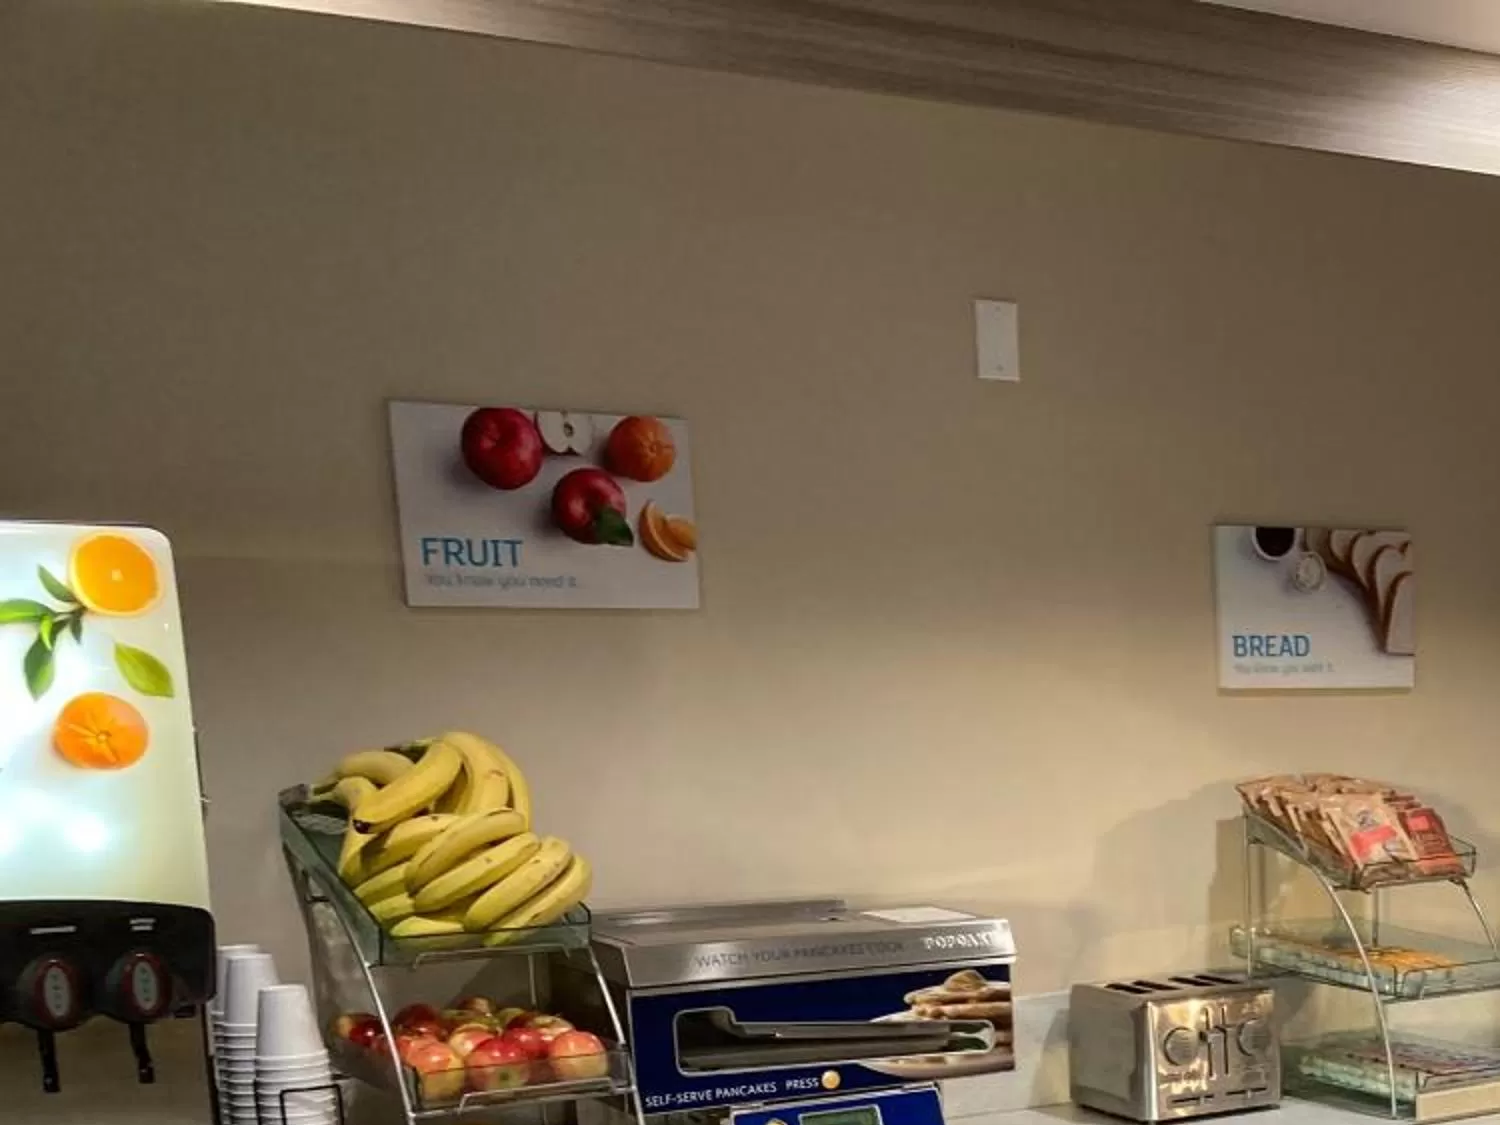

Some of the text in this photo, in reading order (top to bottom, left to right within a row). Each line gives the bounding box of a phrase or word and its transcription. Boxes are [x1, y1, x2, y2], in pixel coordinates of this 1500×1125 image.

[421, 537, 524, 568] FRUIT
[1232, 635, 1310, 657] BREAD
[696, 952, 748, 967] WATCH
[645, 1078, 819, 1107] SELF-SERVE PANCAKES PRESS
